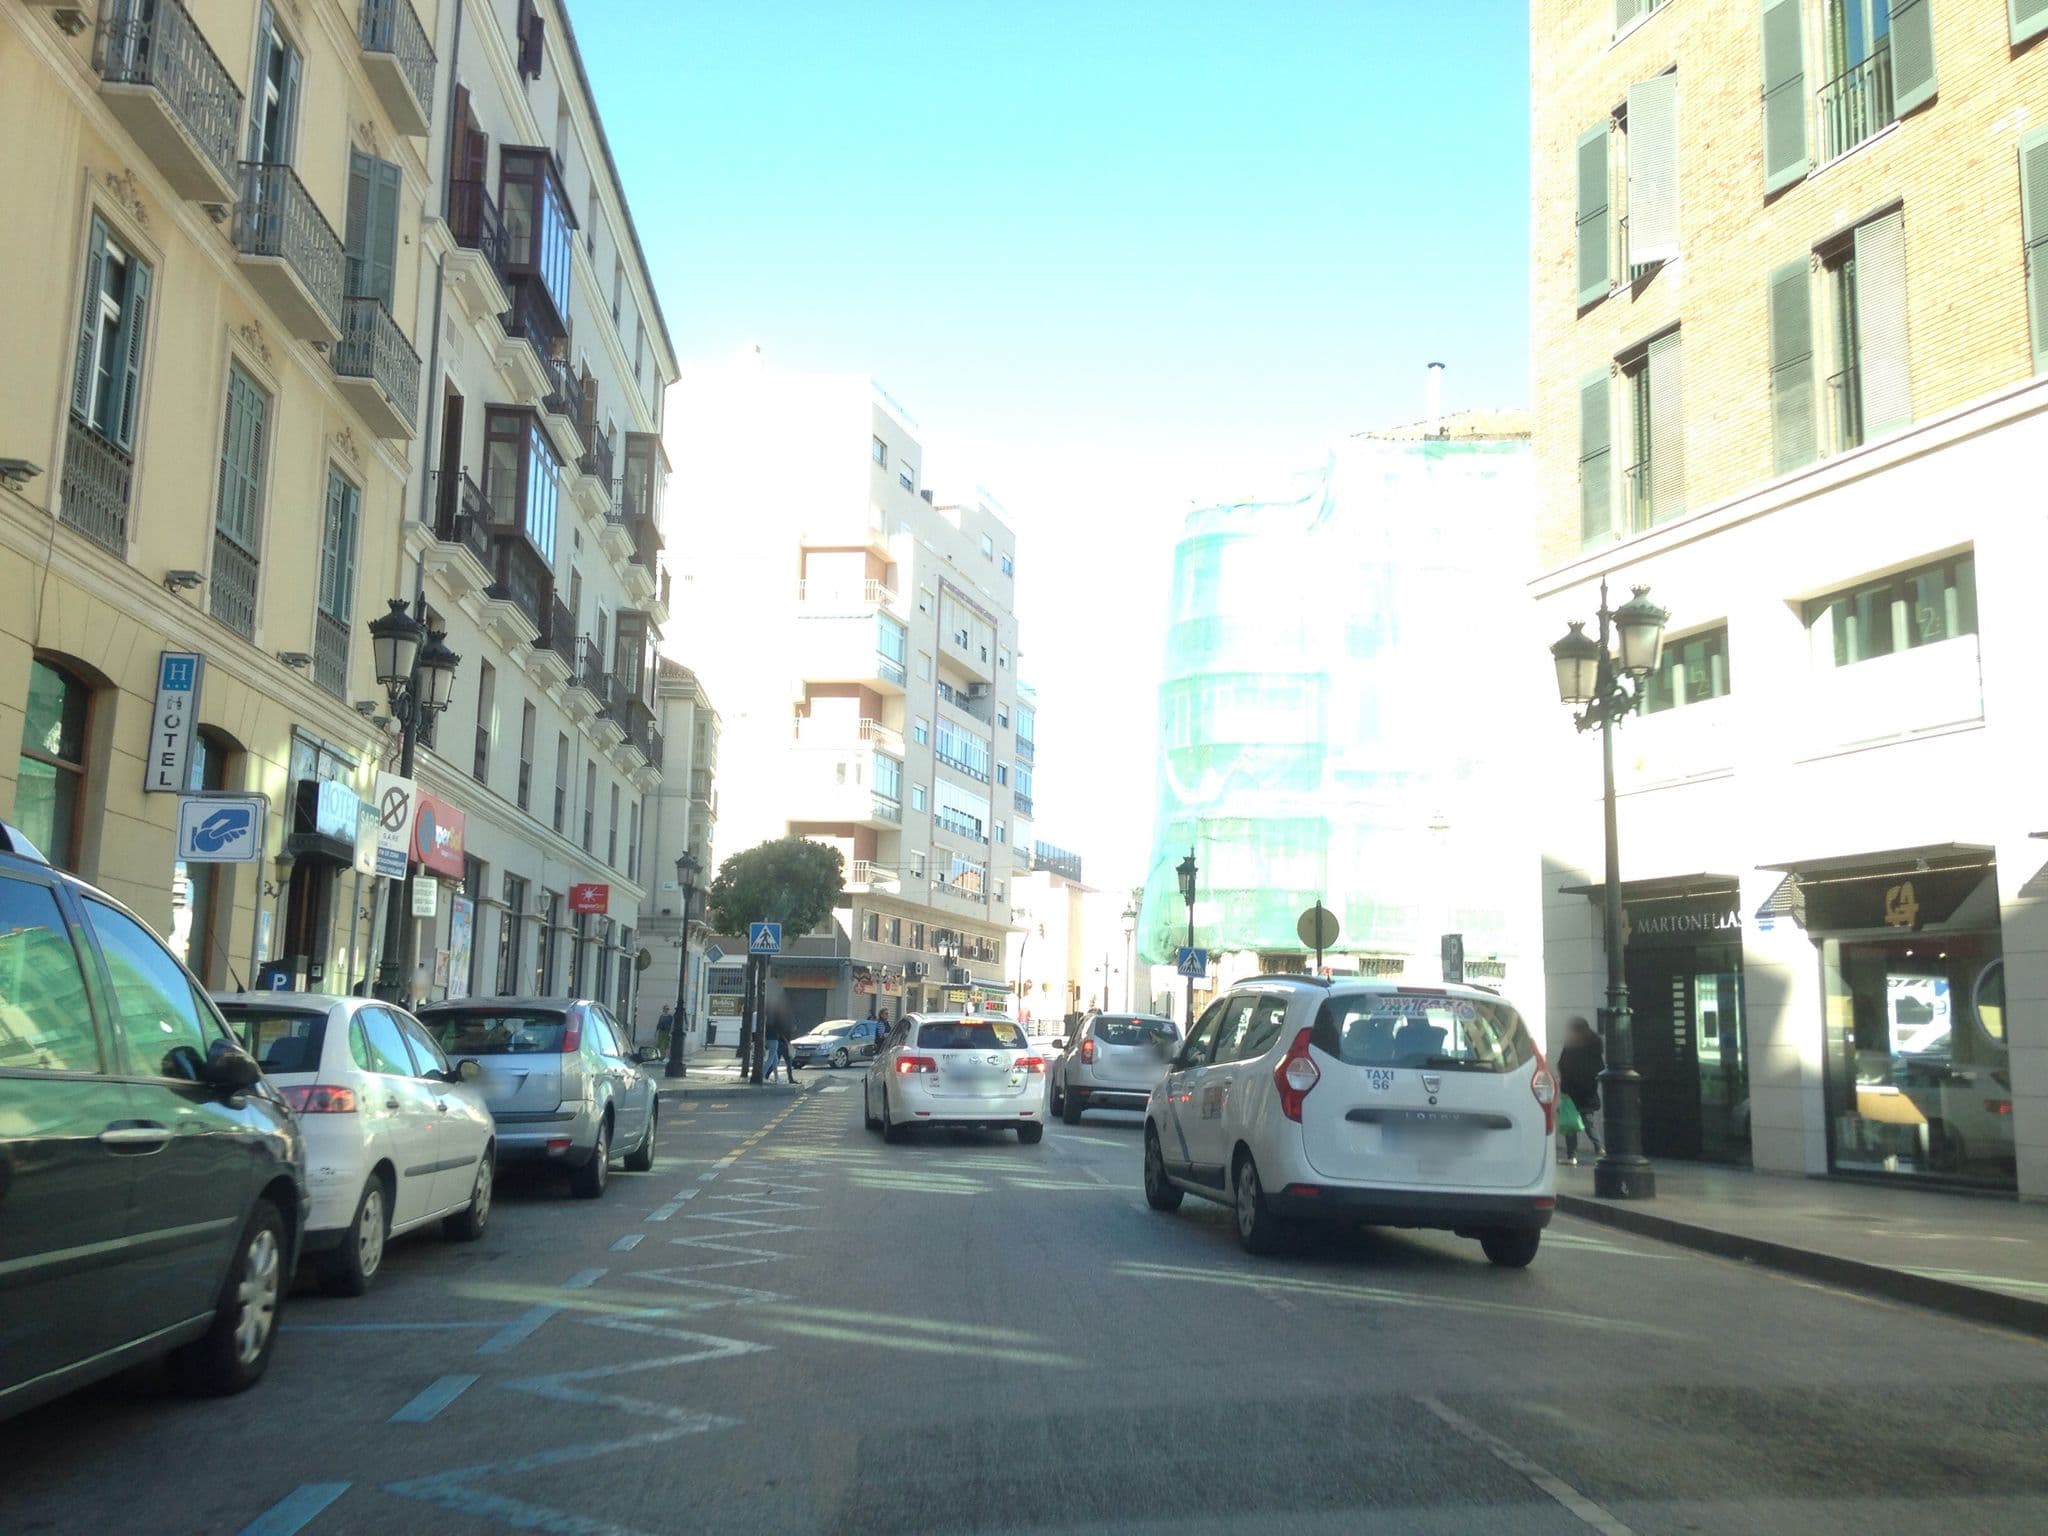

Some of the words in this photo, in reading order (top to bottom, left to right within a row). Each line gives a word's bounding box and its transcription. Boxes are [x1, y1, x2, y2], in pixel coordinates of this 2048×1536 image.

[160, 696, 182, 786] HOTEL
[272, 973, 287, 991] P
[1366, 1069, 1395, 1080] TAXI
[1373, 1080, 1389, 1090] 56
